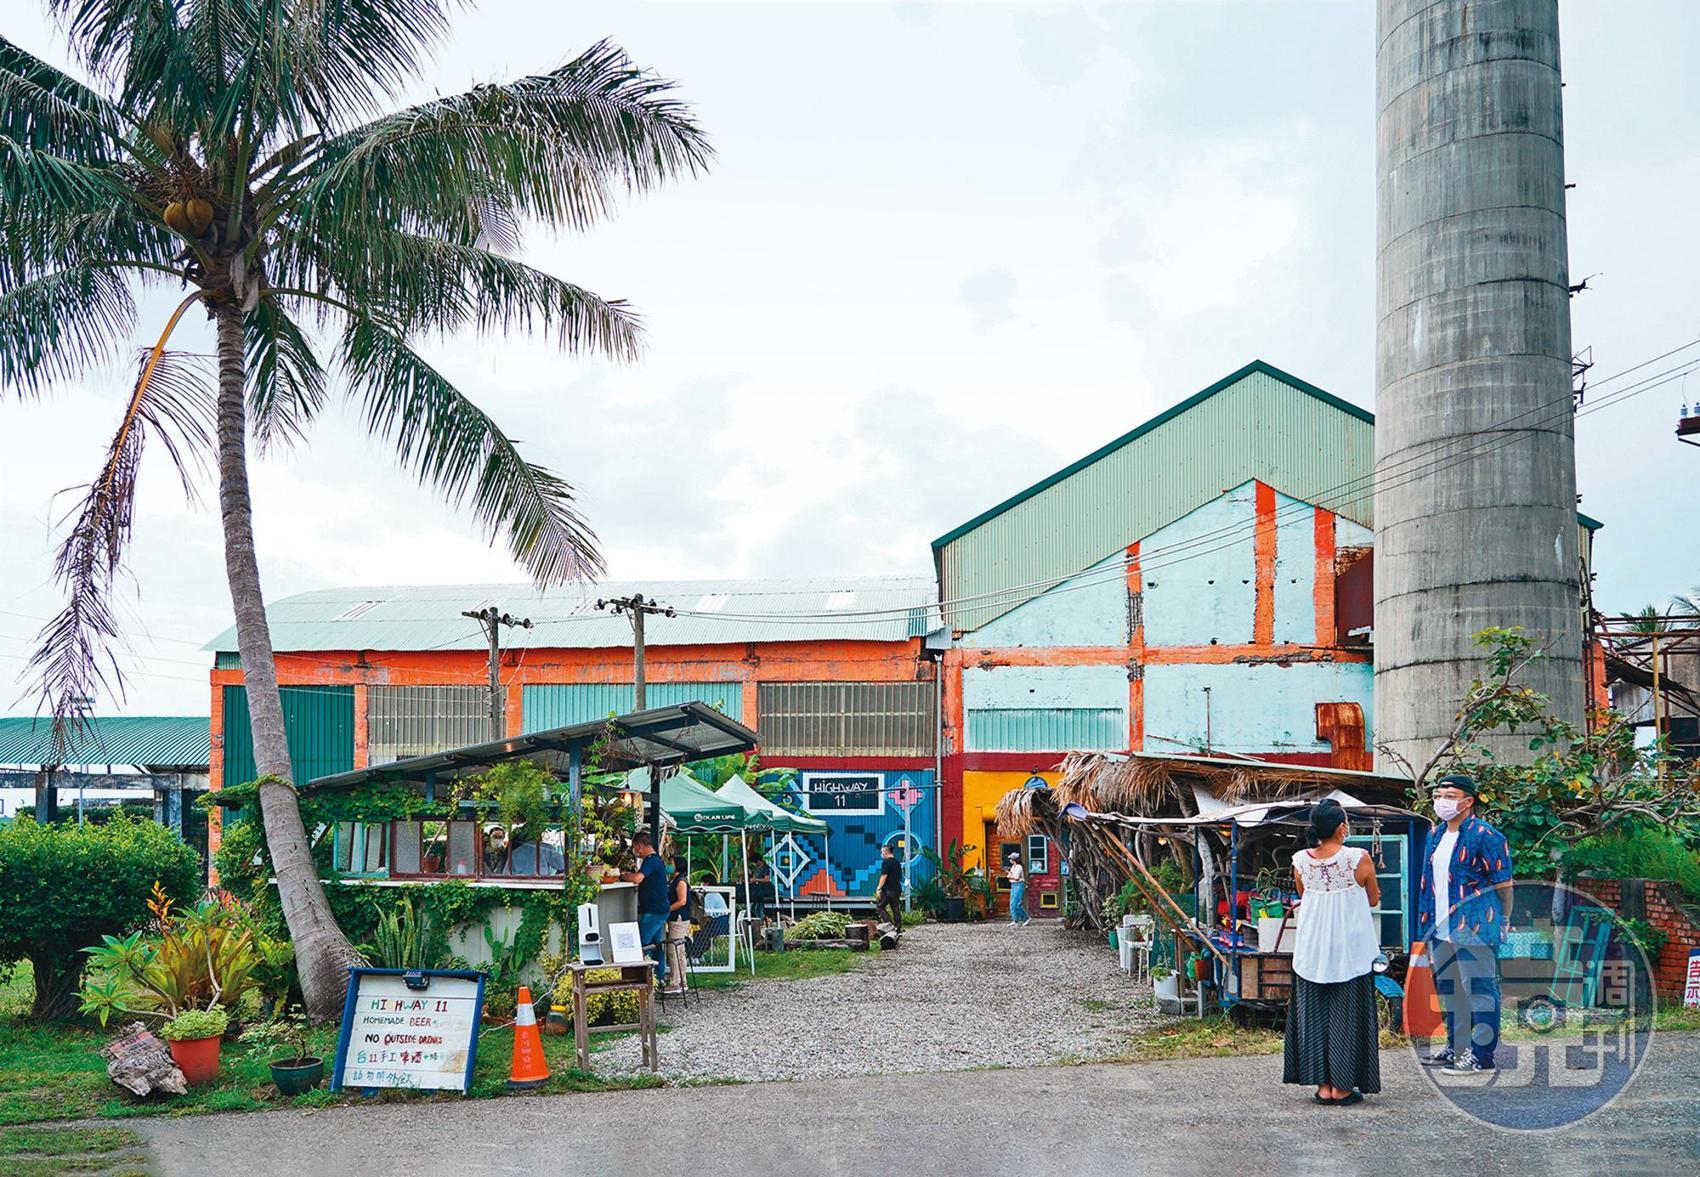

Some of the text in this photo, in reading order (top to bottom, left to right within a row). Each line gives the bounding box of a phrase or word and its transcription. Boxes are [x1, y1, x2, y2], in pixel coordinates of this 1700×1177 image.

[834, 794, 846, 807] 11
[435, 1001, 448, 1012] 11
[362, 1016, 405, 1025] HOMEMADE
[365, 1033, 380, 1044] NO
